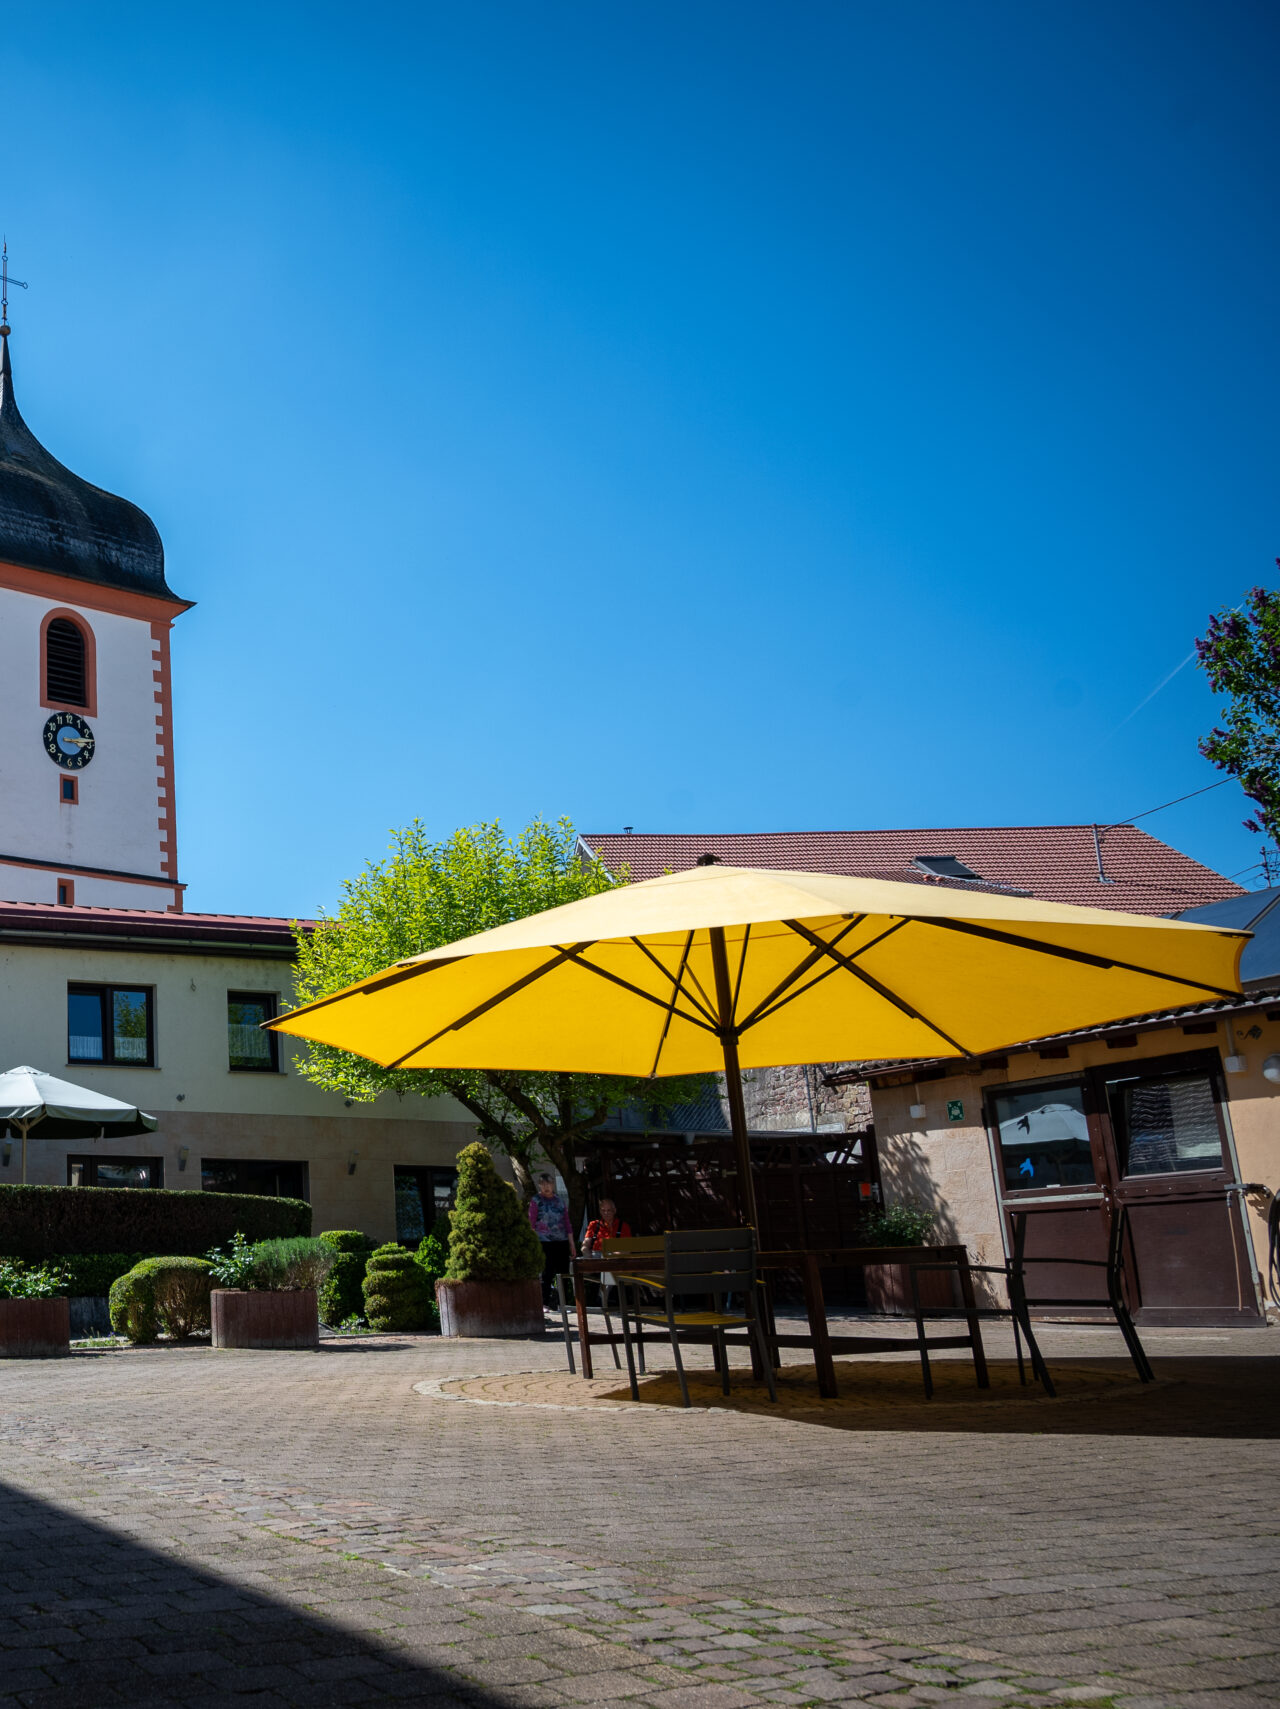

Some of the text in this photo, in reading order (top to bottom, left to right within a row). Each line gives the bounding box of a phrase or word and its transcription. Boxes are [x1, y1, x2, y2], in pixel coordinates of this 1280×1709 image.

[57, 716, 62, 724] 11
[66, 714, 73, 724] 12
[77, 719, 80, 728] 1
[50, 722, 56, 730] 10
[48, 732, 53, 741] 9
[84, 728, 89, 738] 2
[50, 744, 56, 753] 8
[58, 753, 62, 762] 7
[84, 750, 89, 759] 4
[67, 758, 72, 766] 6
[77, 758, 82, 766] 5
